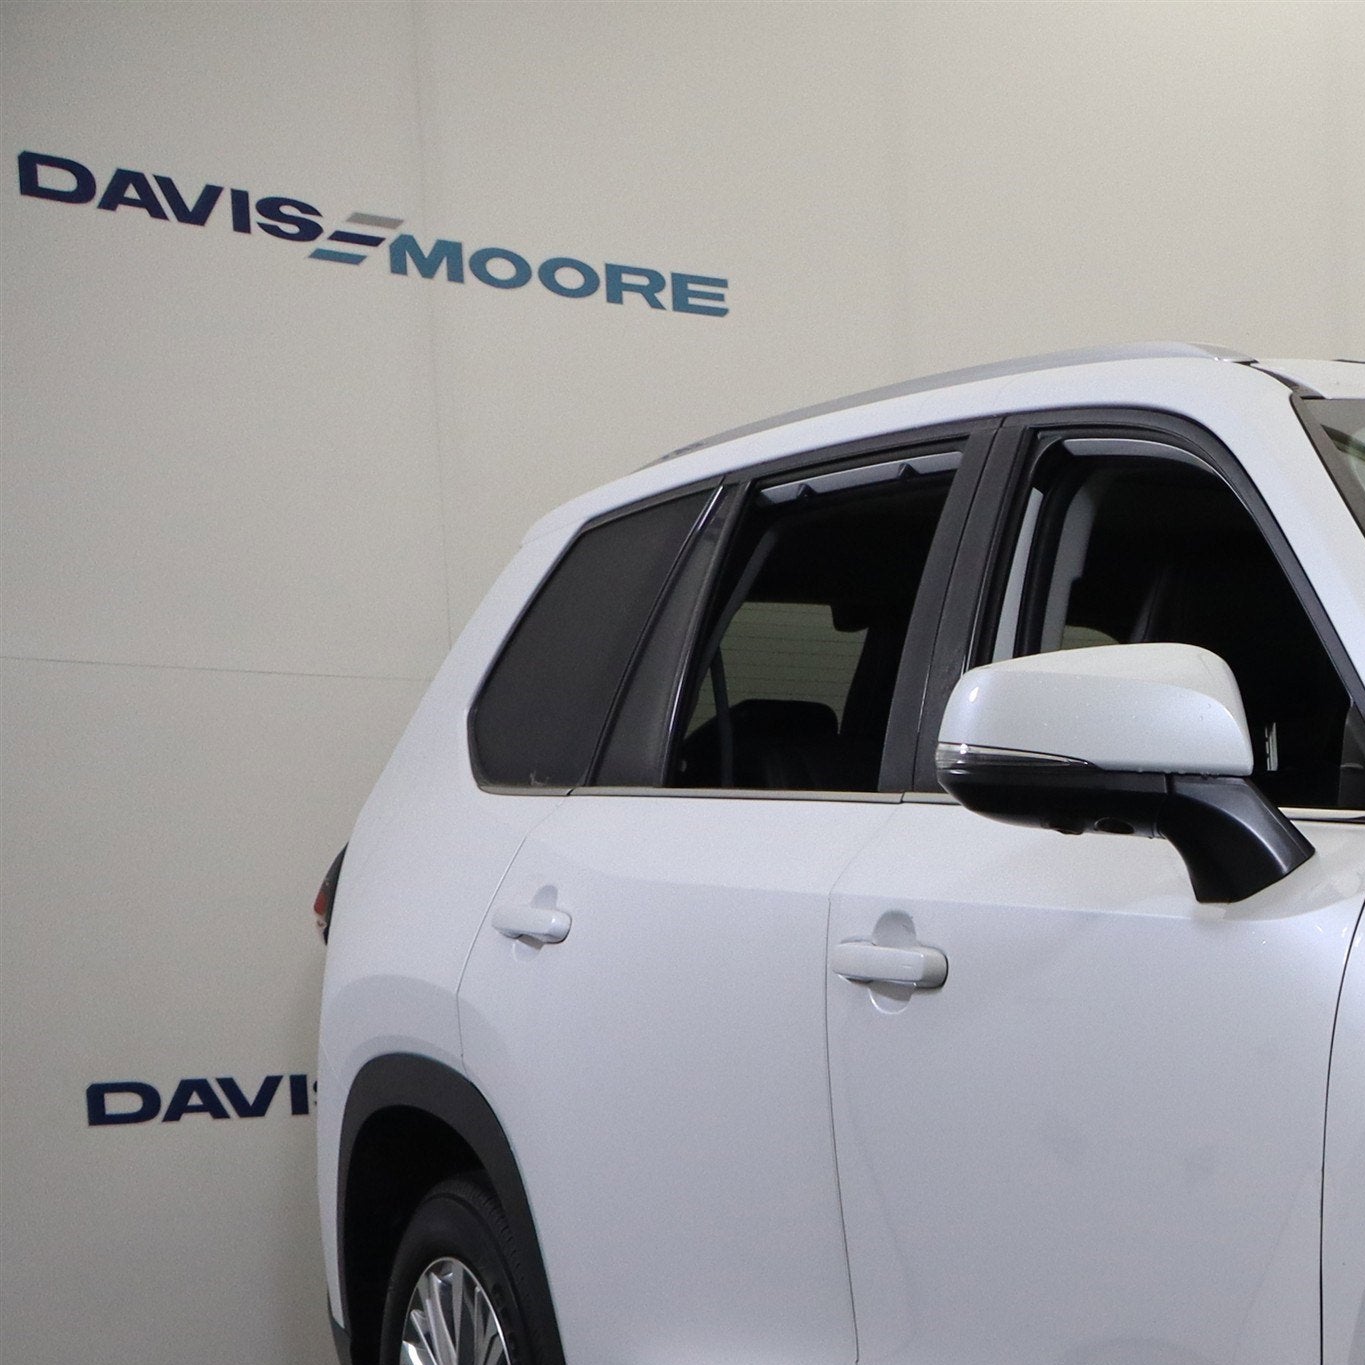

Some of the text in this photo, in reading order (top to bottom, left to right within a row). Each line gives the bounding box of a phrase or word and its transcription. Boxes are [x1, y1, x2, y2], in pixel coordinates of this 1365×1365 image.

[18, 150, 730, 318] DAVIS MOORE
[86, 1073, 317, 1126] DAVI
